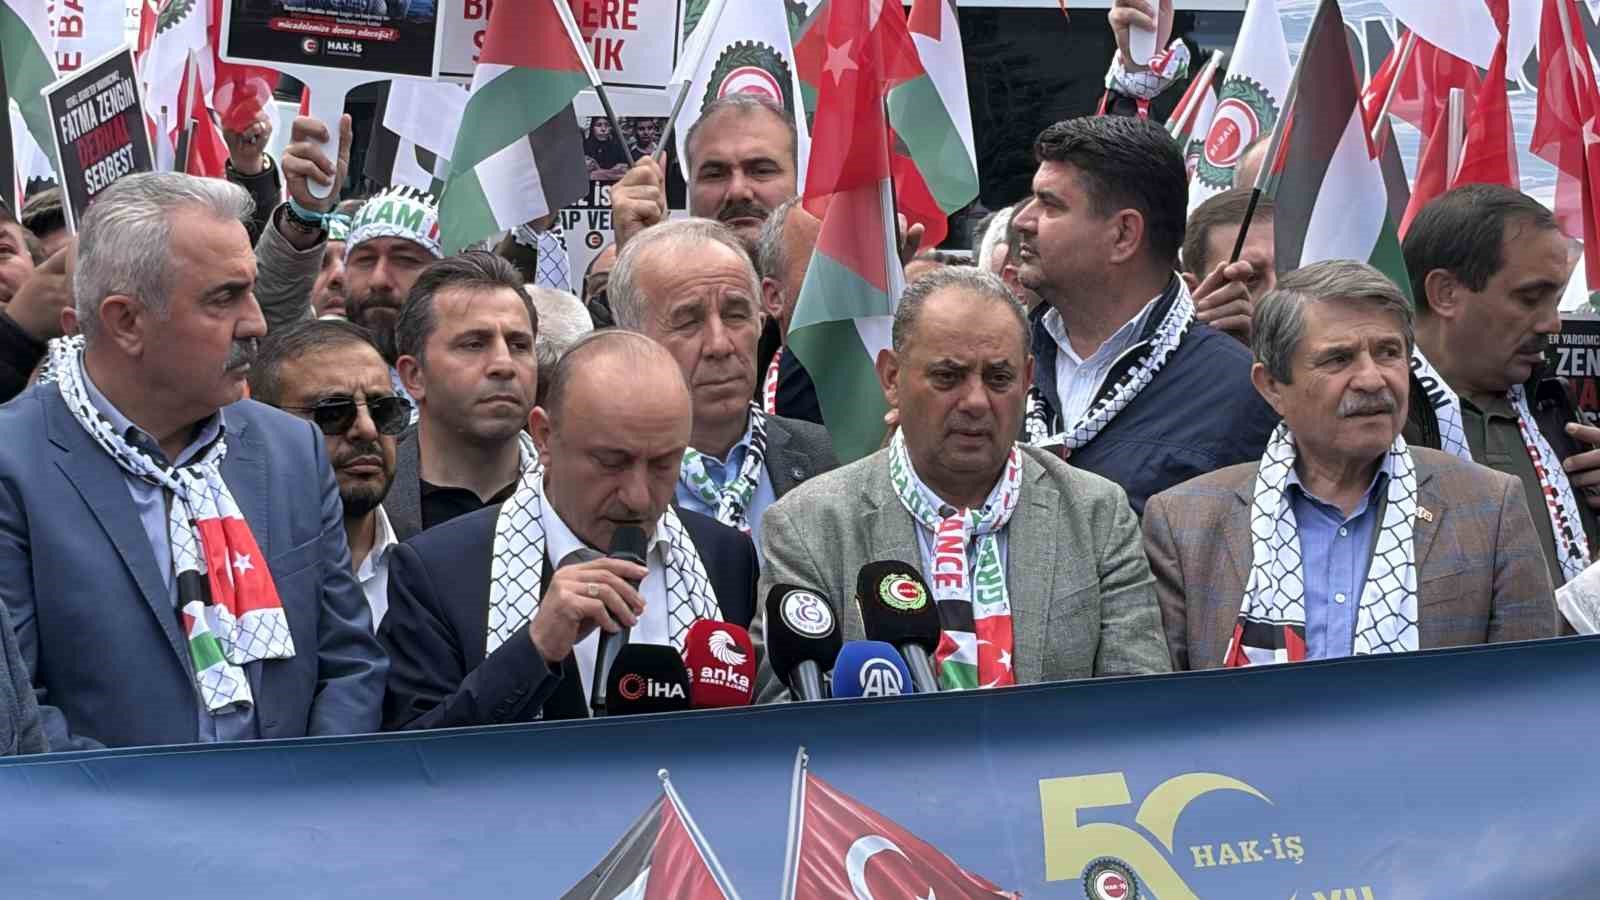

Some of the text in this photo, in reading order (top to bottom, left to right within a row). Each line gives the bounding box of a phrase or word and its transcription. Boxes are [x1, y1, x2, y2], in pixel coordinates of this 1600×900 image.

[60, 100, 99, 145] FATMA
[96, 76, 136, 124] ZENGİN
[84, 143, 135, 195] SERBEST
[647, 678, 687, 699] İHA
[700, 665, 750, 689] anka
[1189, 832, 1305, 868] HAK-İŞ
